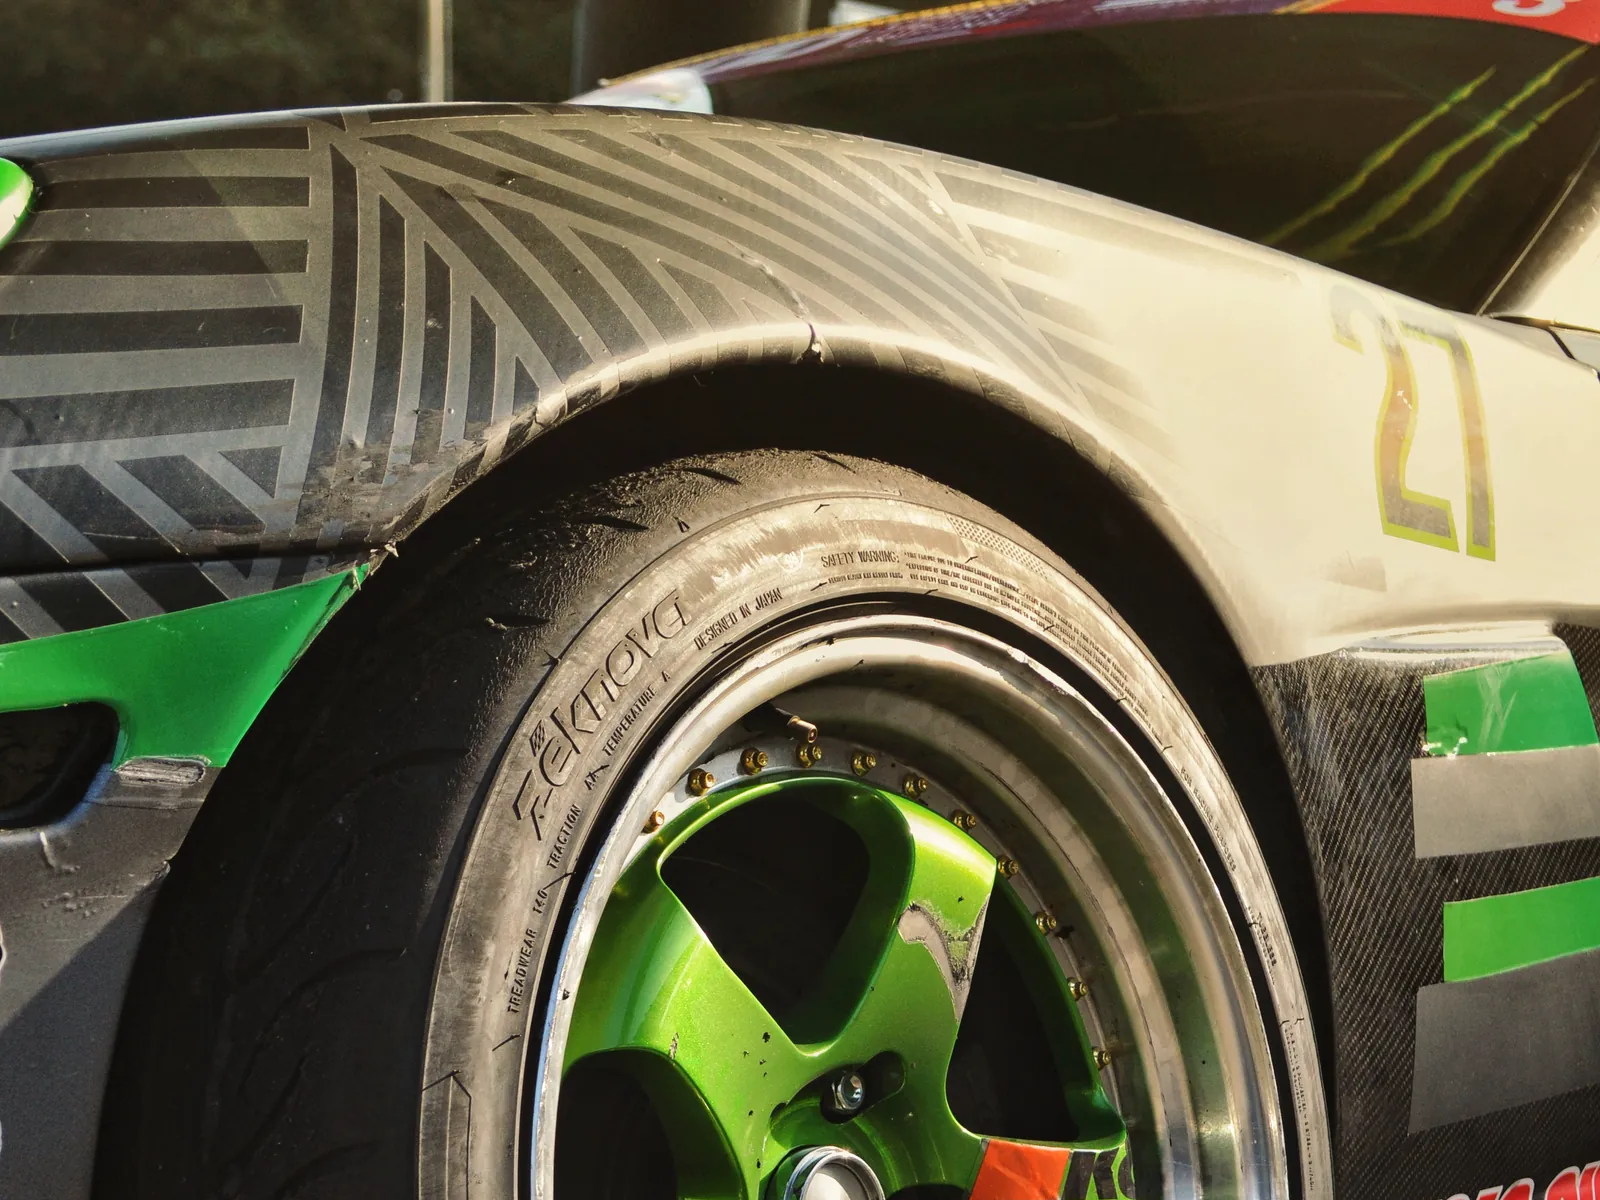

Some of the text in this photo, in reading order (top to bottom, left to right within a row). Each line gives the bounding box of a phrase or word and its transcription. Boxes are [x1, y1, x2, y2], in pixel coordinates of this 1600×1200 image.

[1330, 284, 1496, 562] 27
[693, 587, 783, 651] DESIGNED IN JAPAN
[820, 550, 901, 568] SAFETY WARNING:
[507, 928, 538, 1014] TREADWEAR
[546, 803, 582, 870] TRACTION
[601, 683, 658, 756] TEMPERATURE
[661, 670, 671, 683] A
